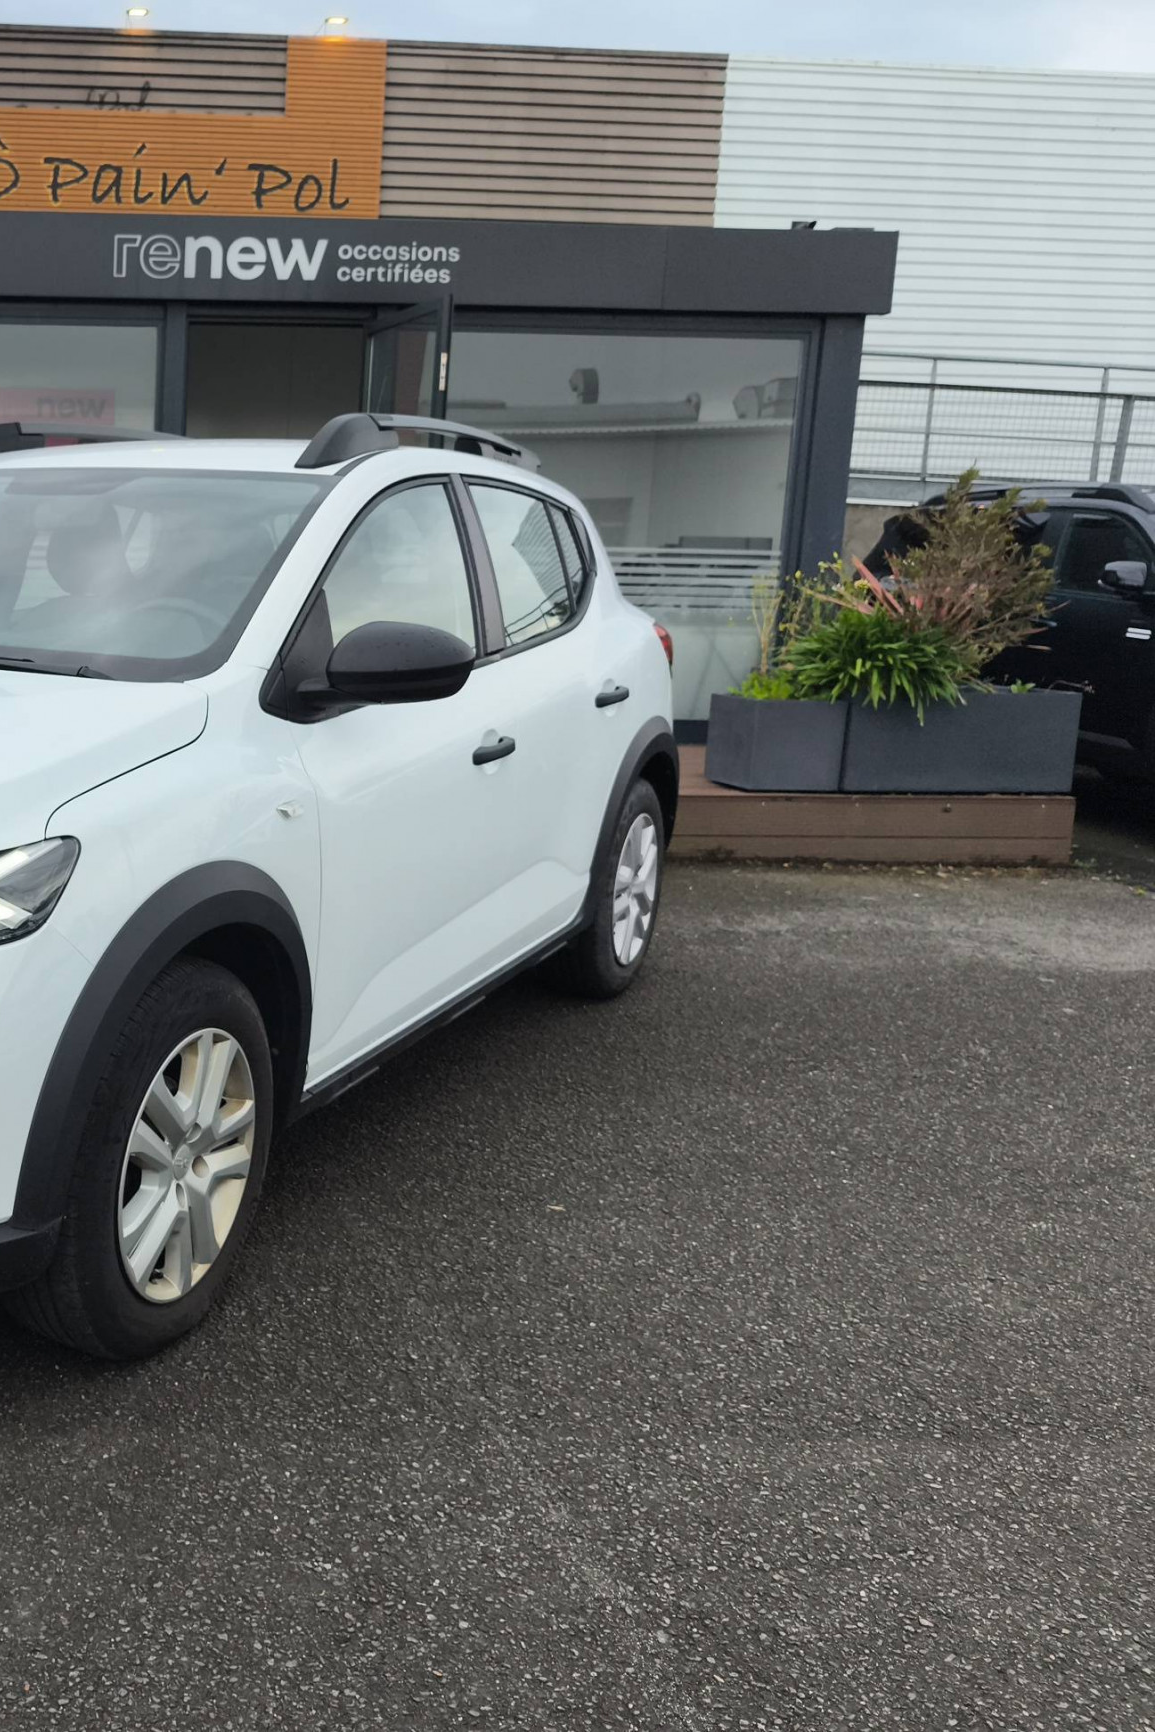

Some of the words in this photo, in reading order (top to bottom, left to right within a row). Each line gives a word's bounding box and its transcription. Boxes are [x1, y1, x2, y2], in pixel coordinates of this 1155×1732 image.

[247, 157, 350, 212] Pol
[112, 234, 329, 281] renew
[337, 241, 461, 262] occasions
[336, 262, 451, 283] certifiées
